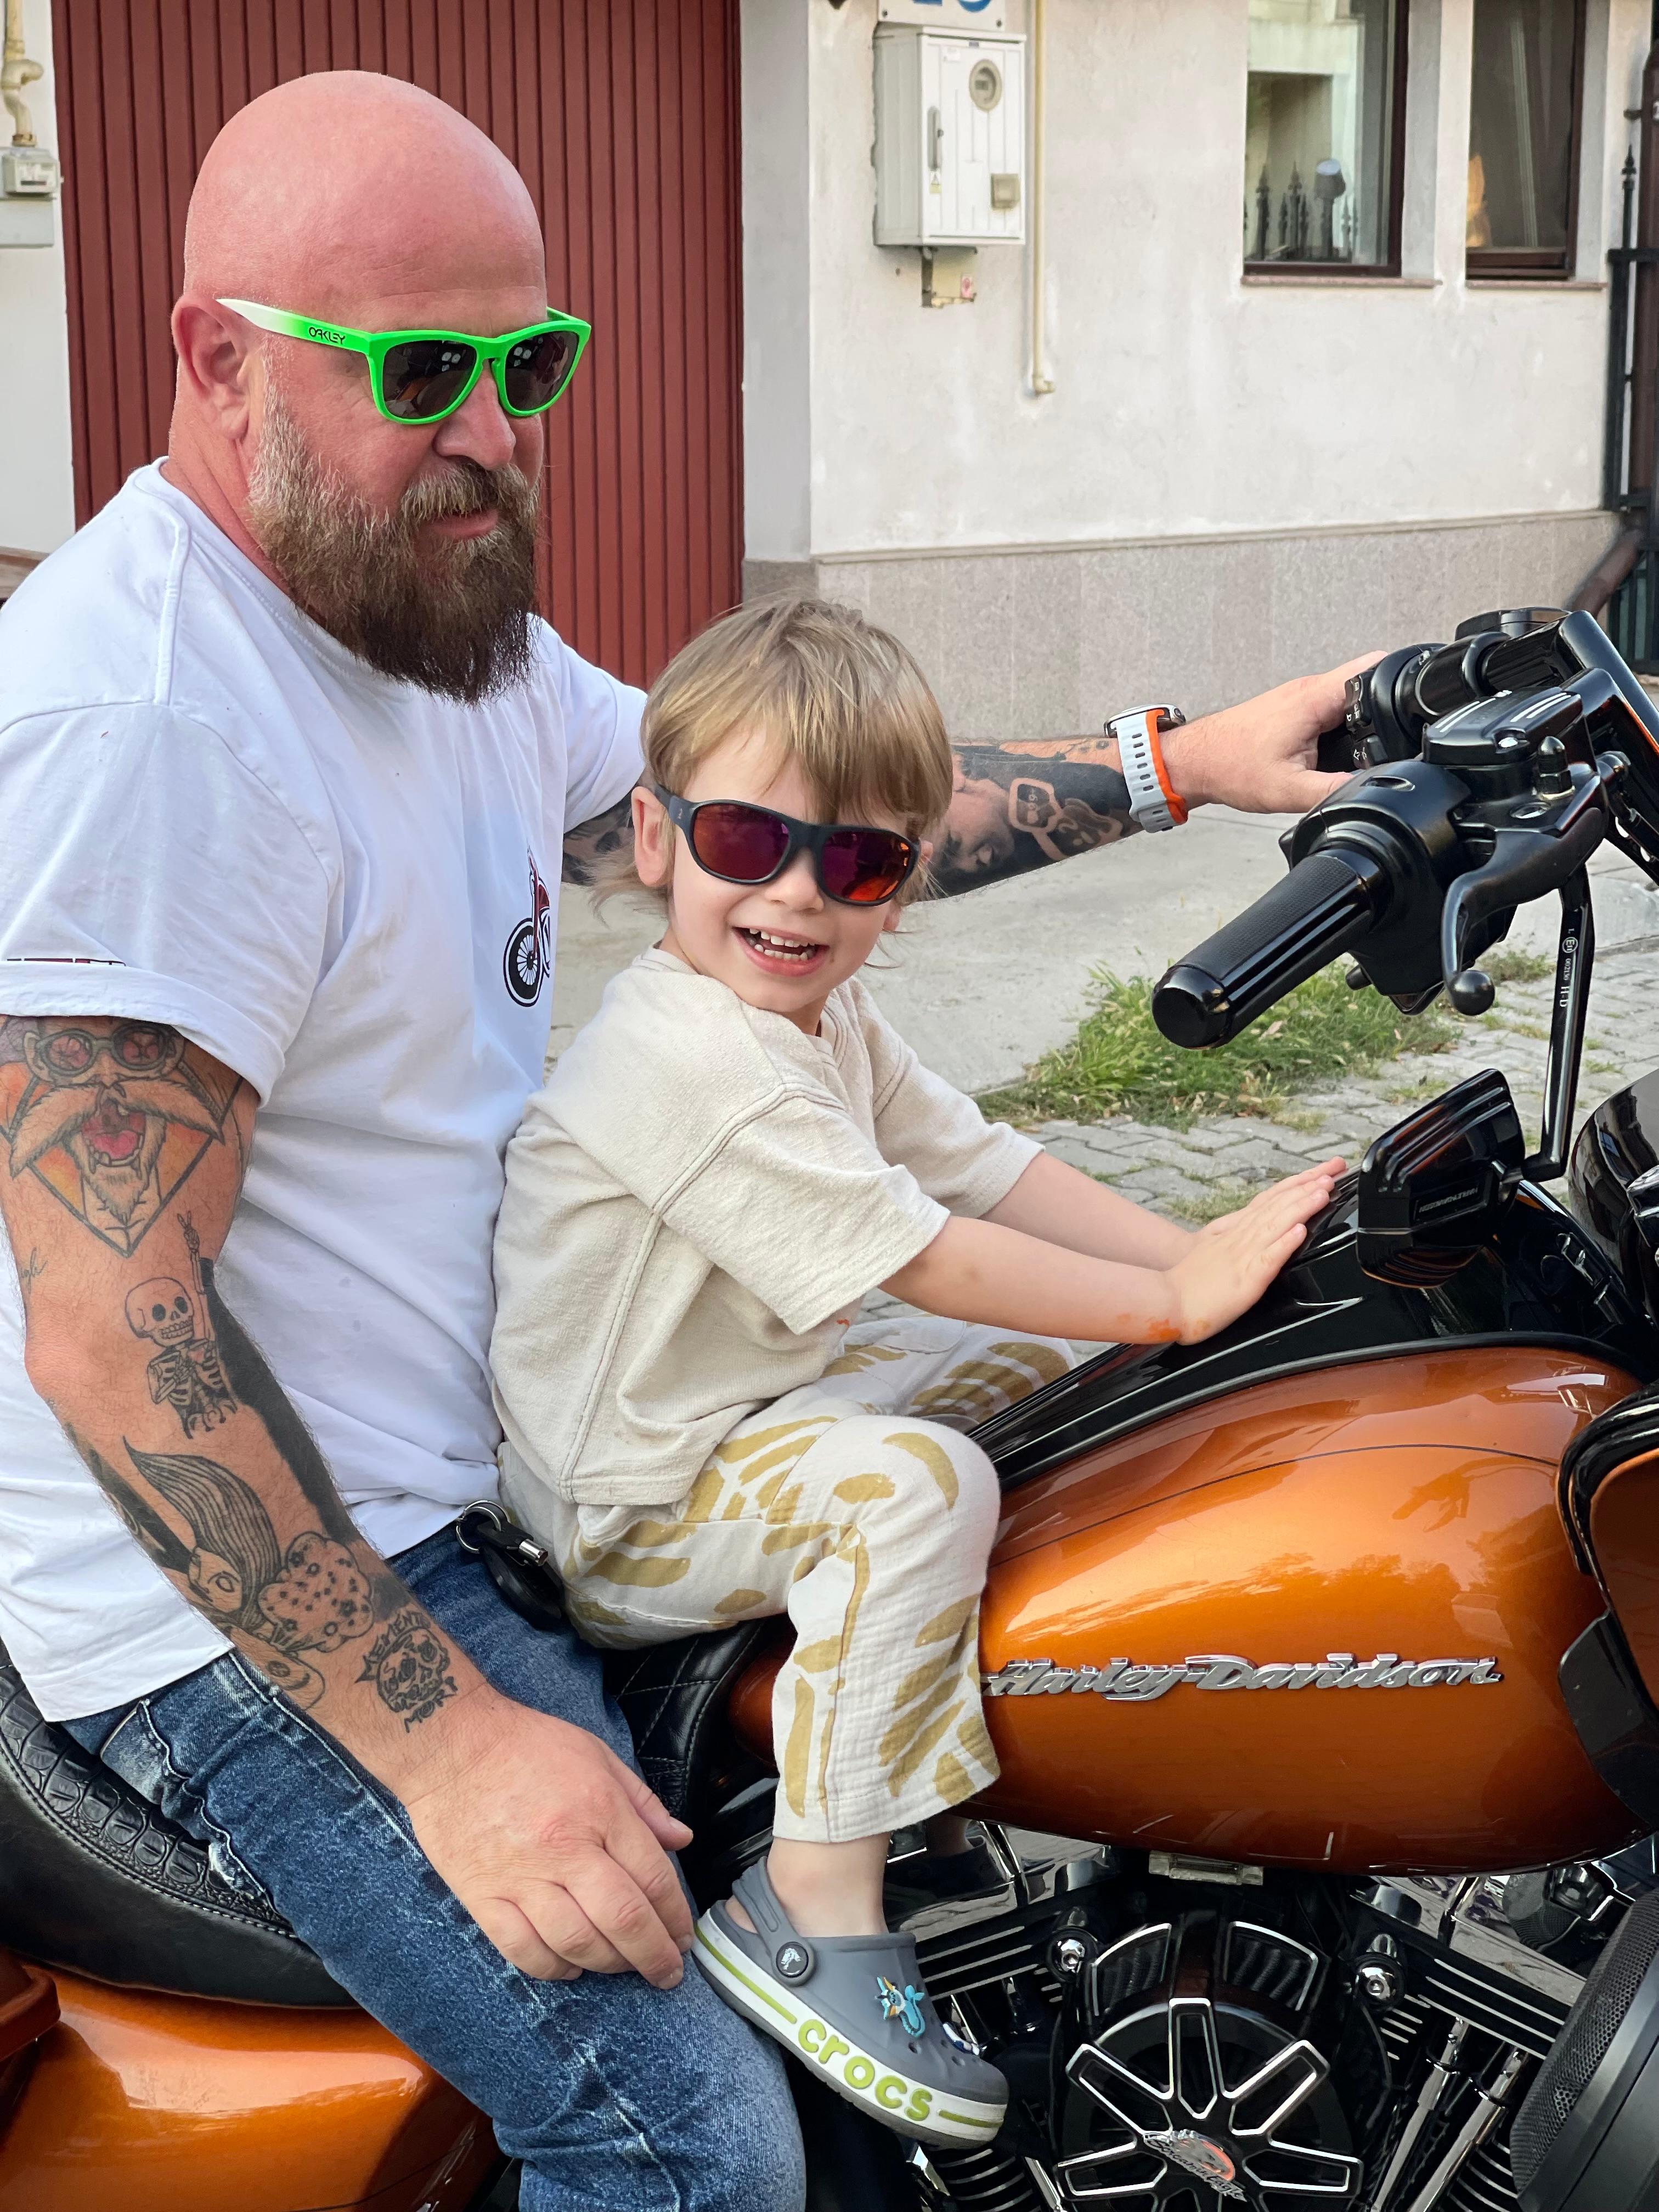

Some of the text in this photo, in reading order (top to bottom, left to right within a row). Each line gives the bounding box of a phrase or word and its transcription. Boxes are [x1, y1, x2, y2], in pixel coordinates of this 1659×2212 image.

[308, 326, 346, 345] OAKLEY
[981, 1653, 1502, 1701] Harley-Davidson
[798, 2019, 932, 2121] crocs
